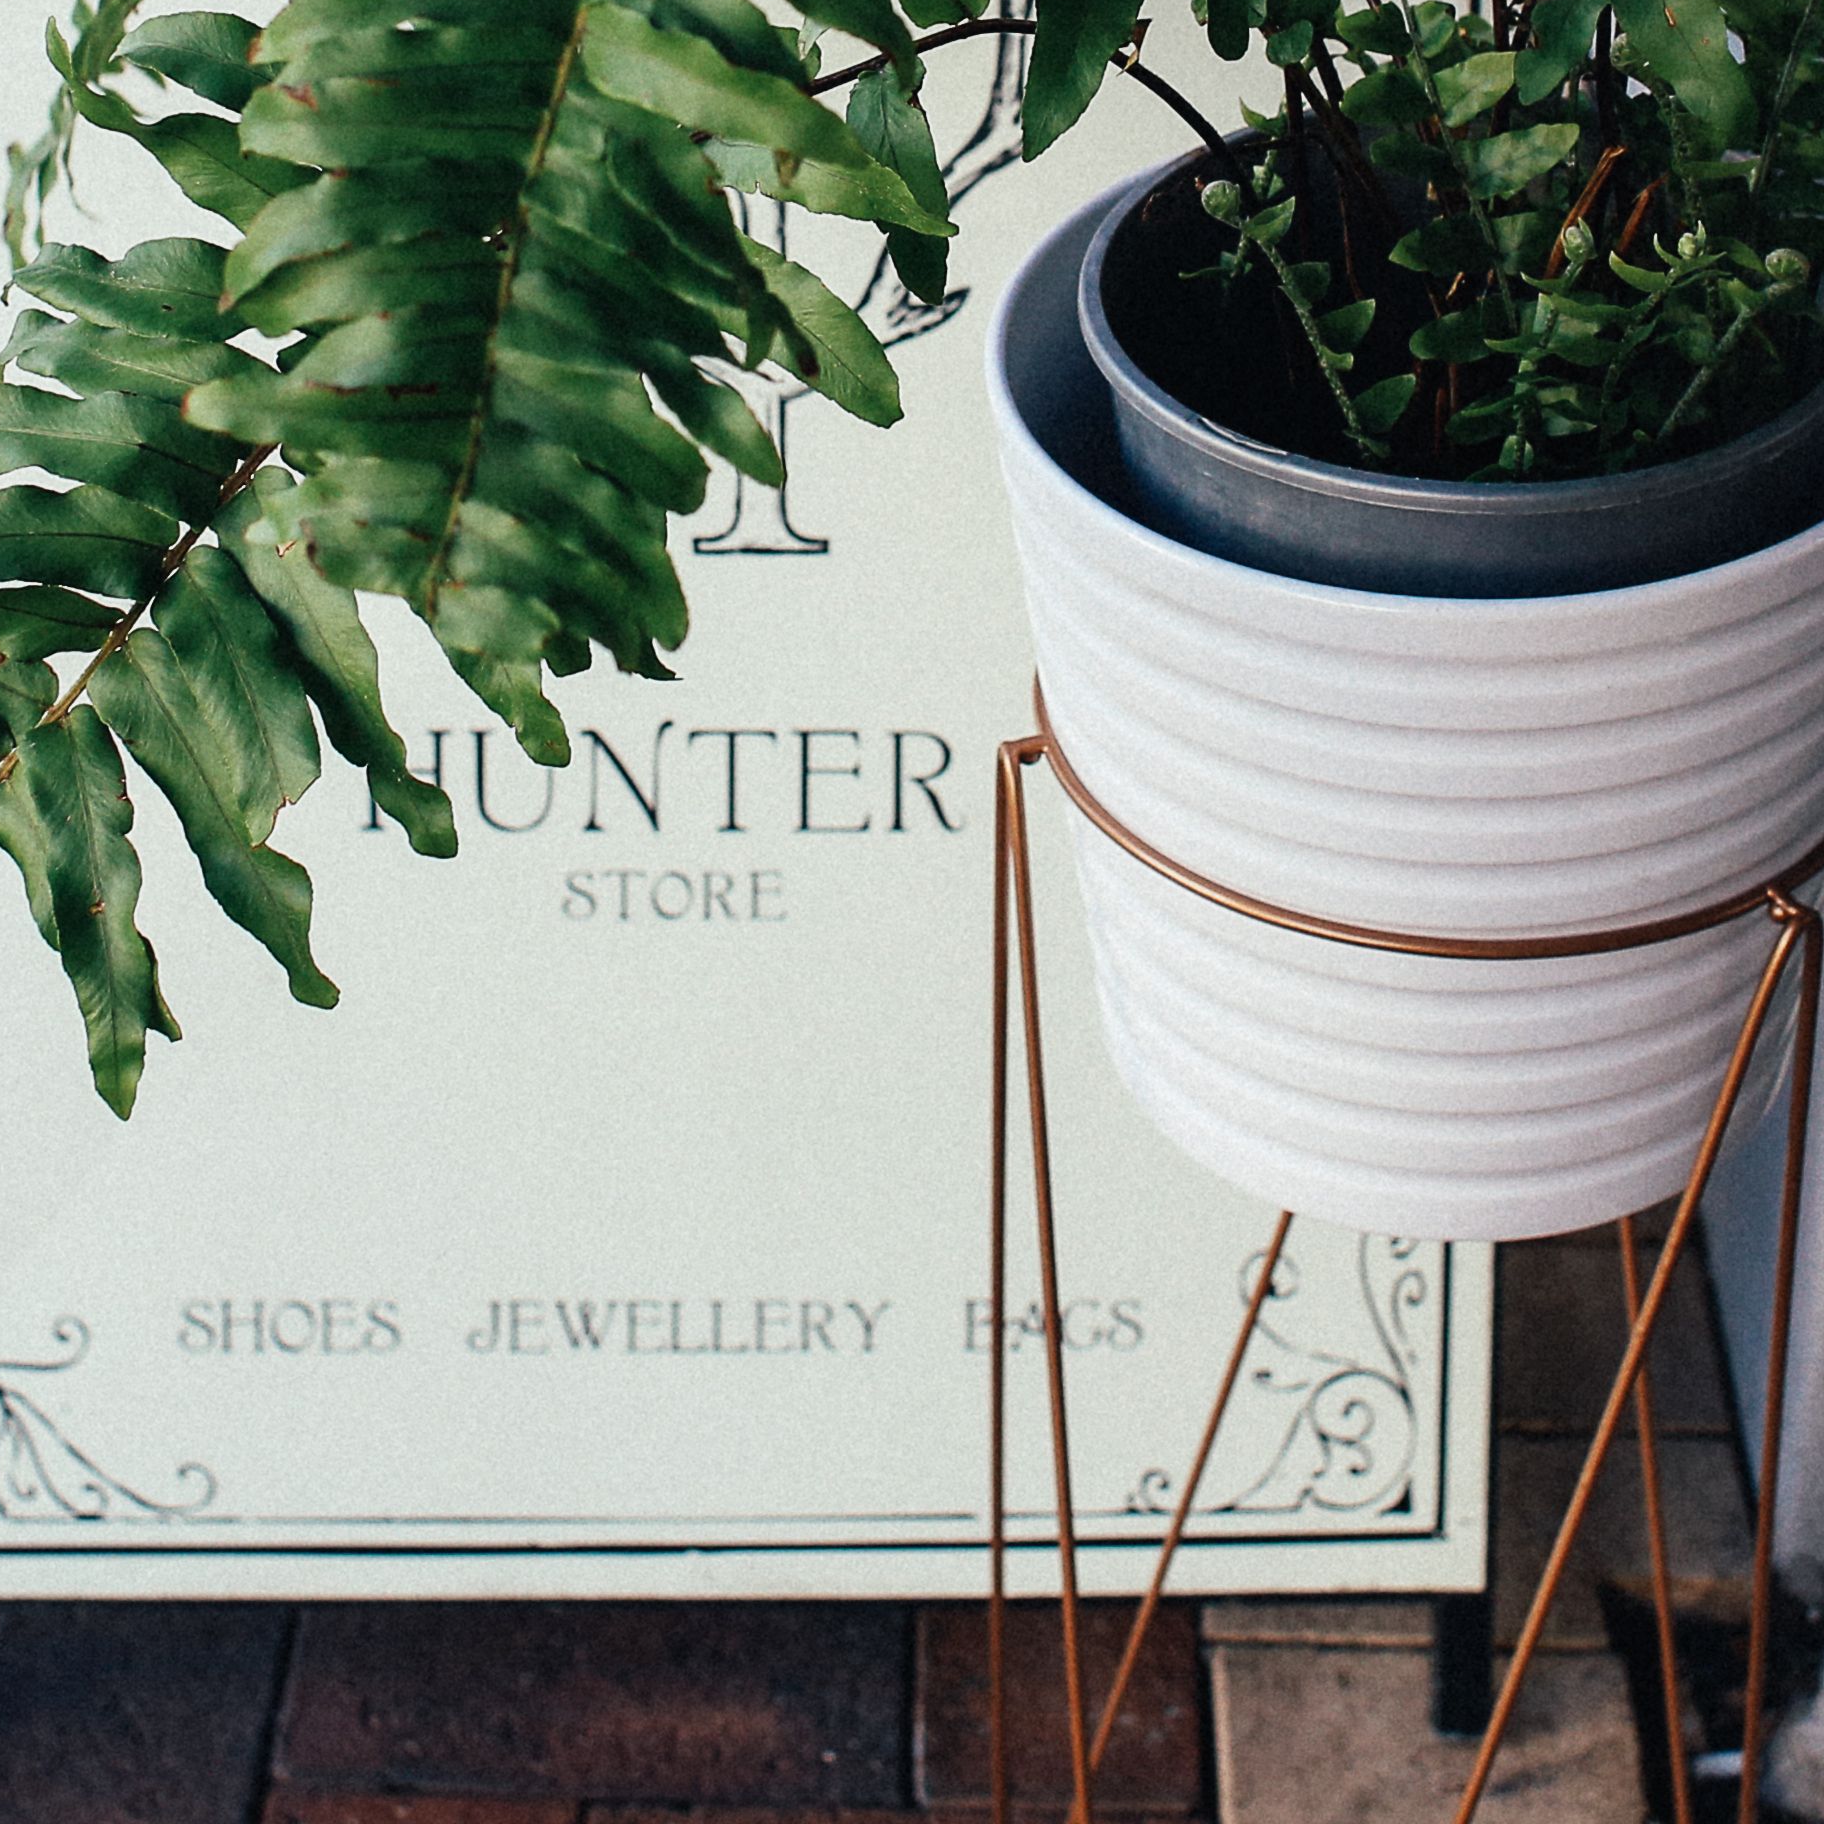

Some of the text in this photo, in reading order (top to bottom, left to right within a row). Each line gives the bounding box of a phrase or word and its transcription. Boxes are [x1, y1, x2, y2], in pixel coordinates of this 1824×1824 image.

[560, 868, 790, 924] STORE
[177, 1297, 1145, 1355] SHOES JEWELLERY BAGS
